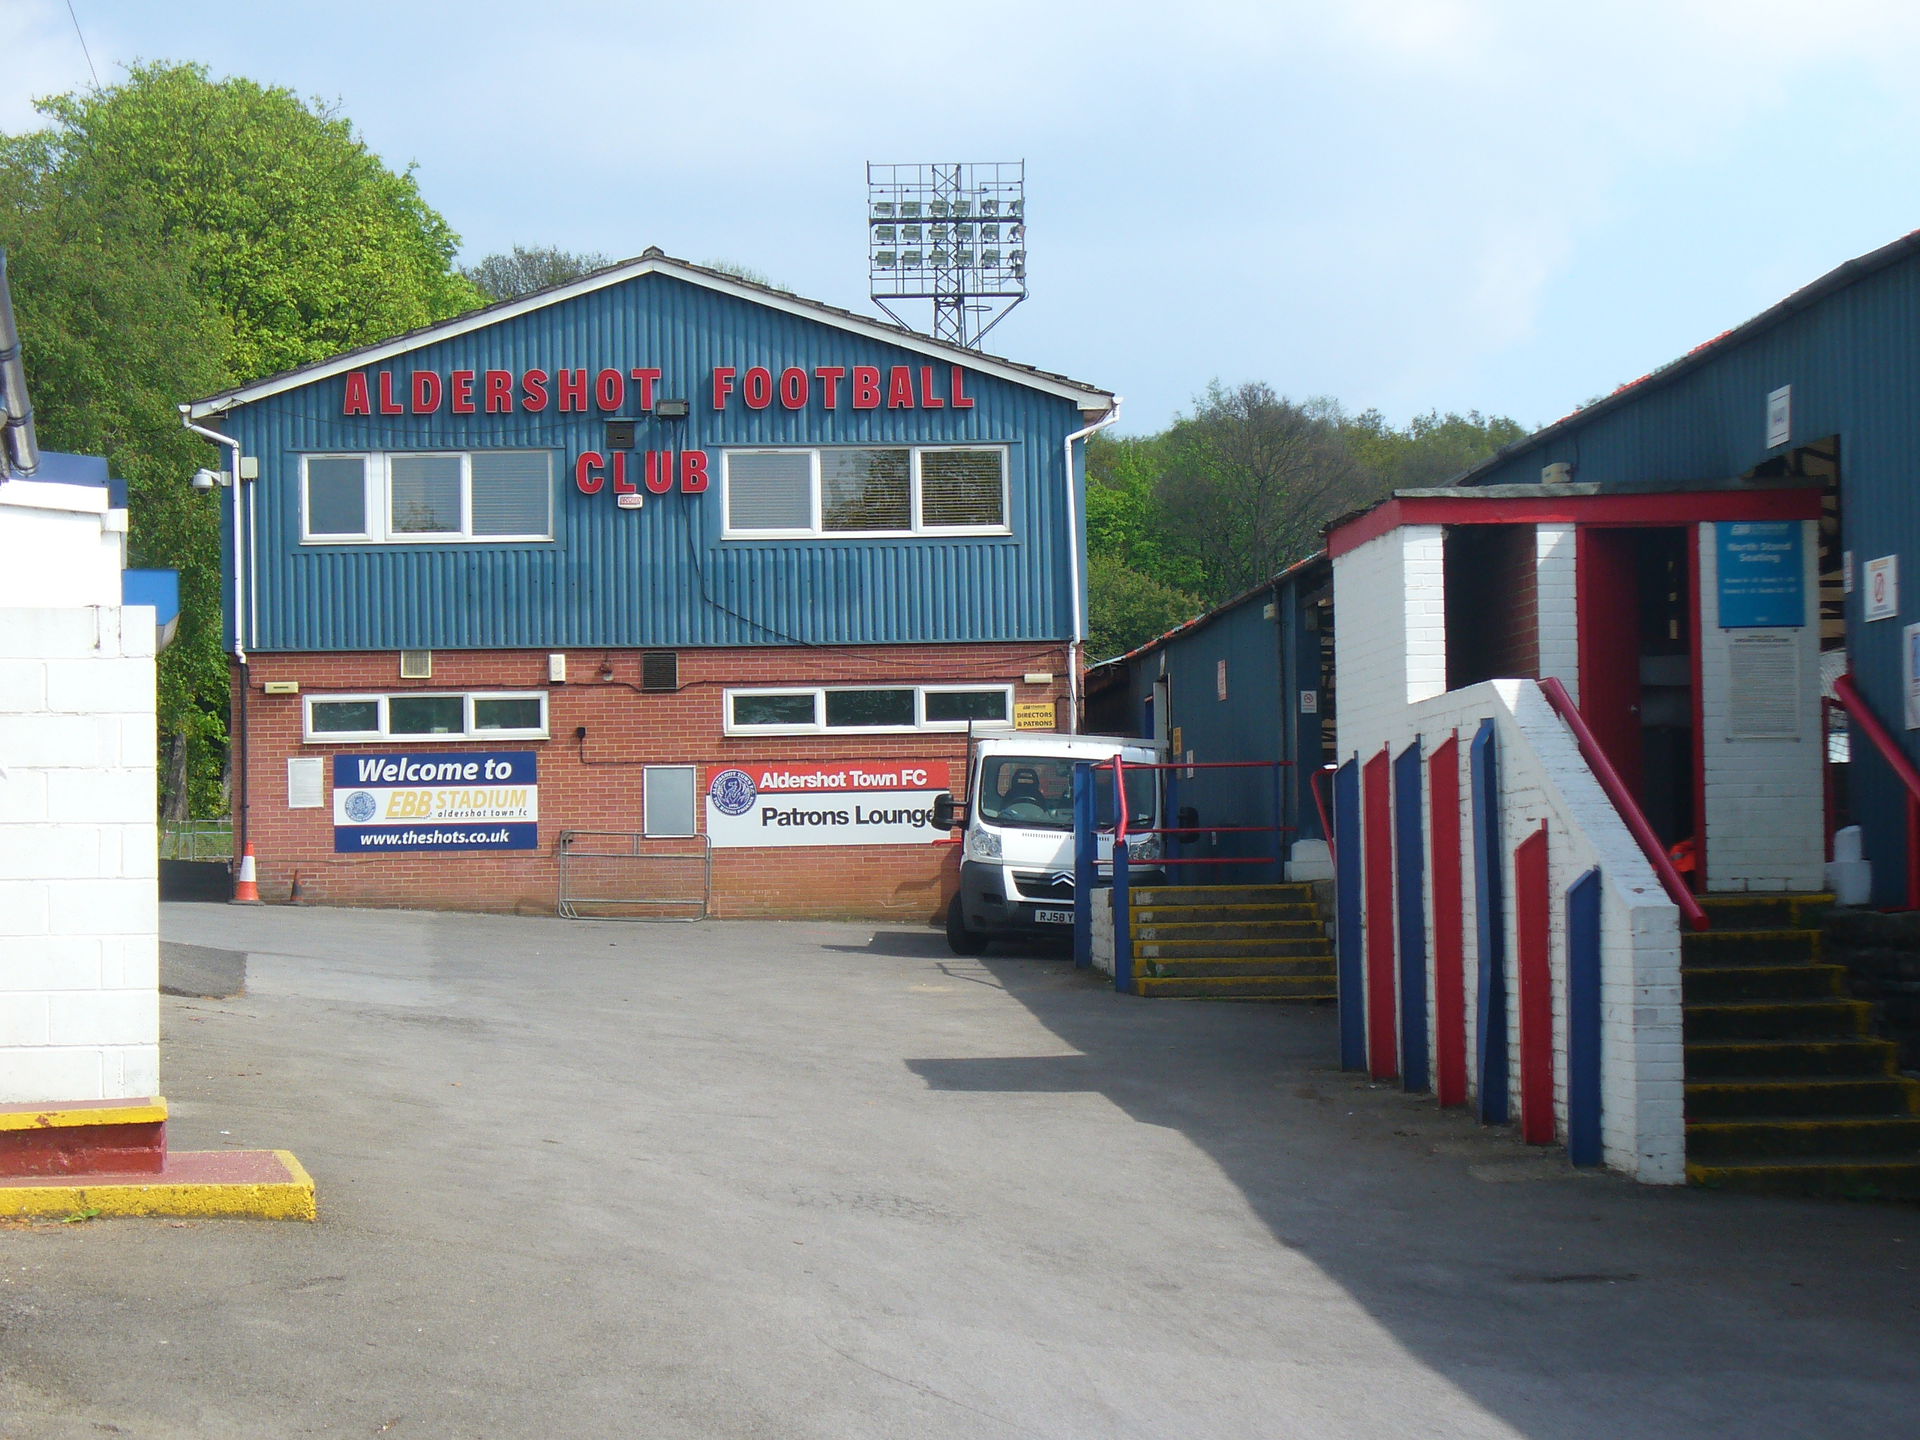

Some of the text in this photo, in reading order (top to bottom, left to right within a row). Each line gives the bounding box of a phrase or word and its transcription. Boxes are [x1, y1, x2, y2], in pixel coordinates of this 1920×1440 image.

[344, 365, 975, 415] ALDERSHOT FOOTBALL
[575, 450, 710, 495] CLUB
[358, 758, 512, 782] Welcome to
[760, 769, 928, 789] Aldershot Town FC
[386, 789, 528, 817] EBB STADIUM
[437, 808, 528, 818] aldershot town fc
[761, 807, 850, 827] Patrons
[360, 829, 510, 846] www.theshots.co.uk
[1039, 911, 1065, 922] RJ58
